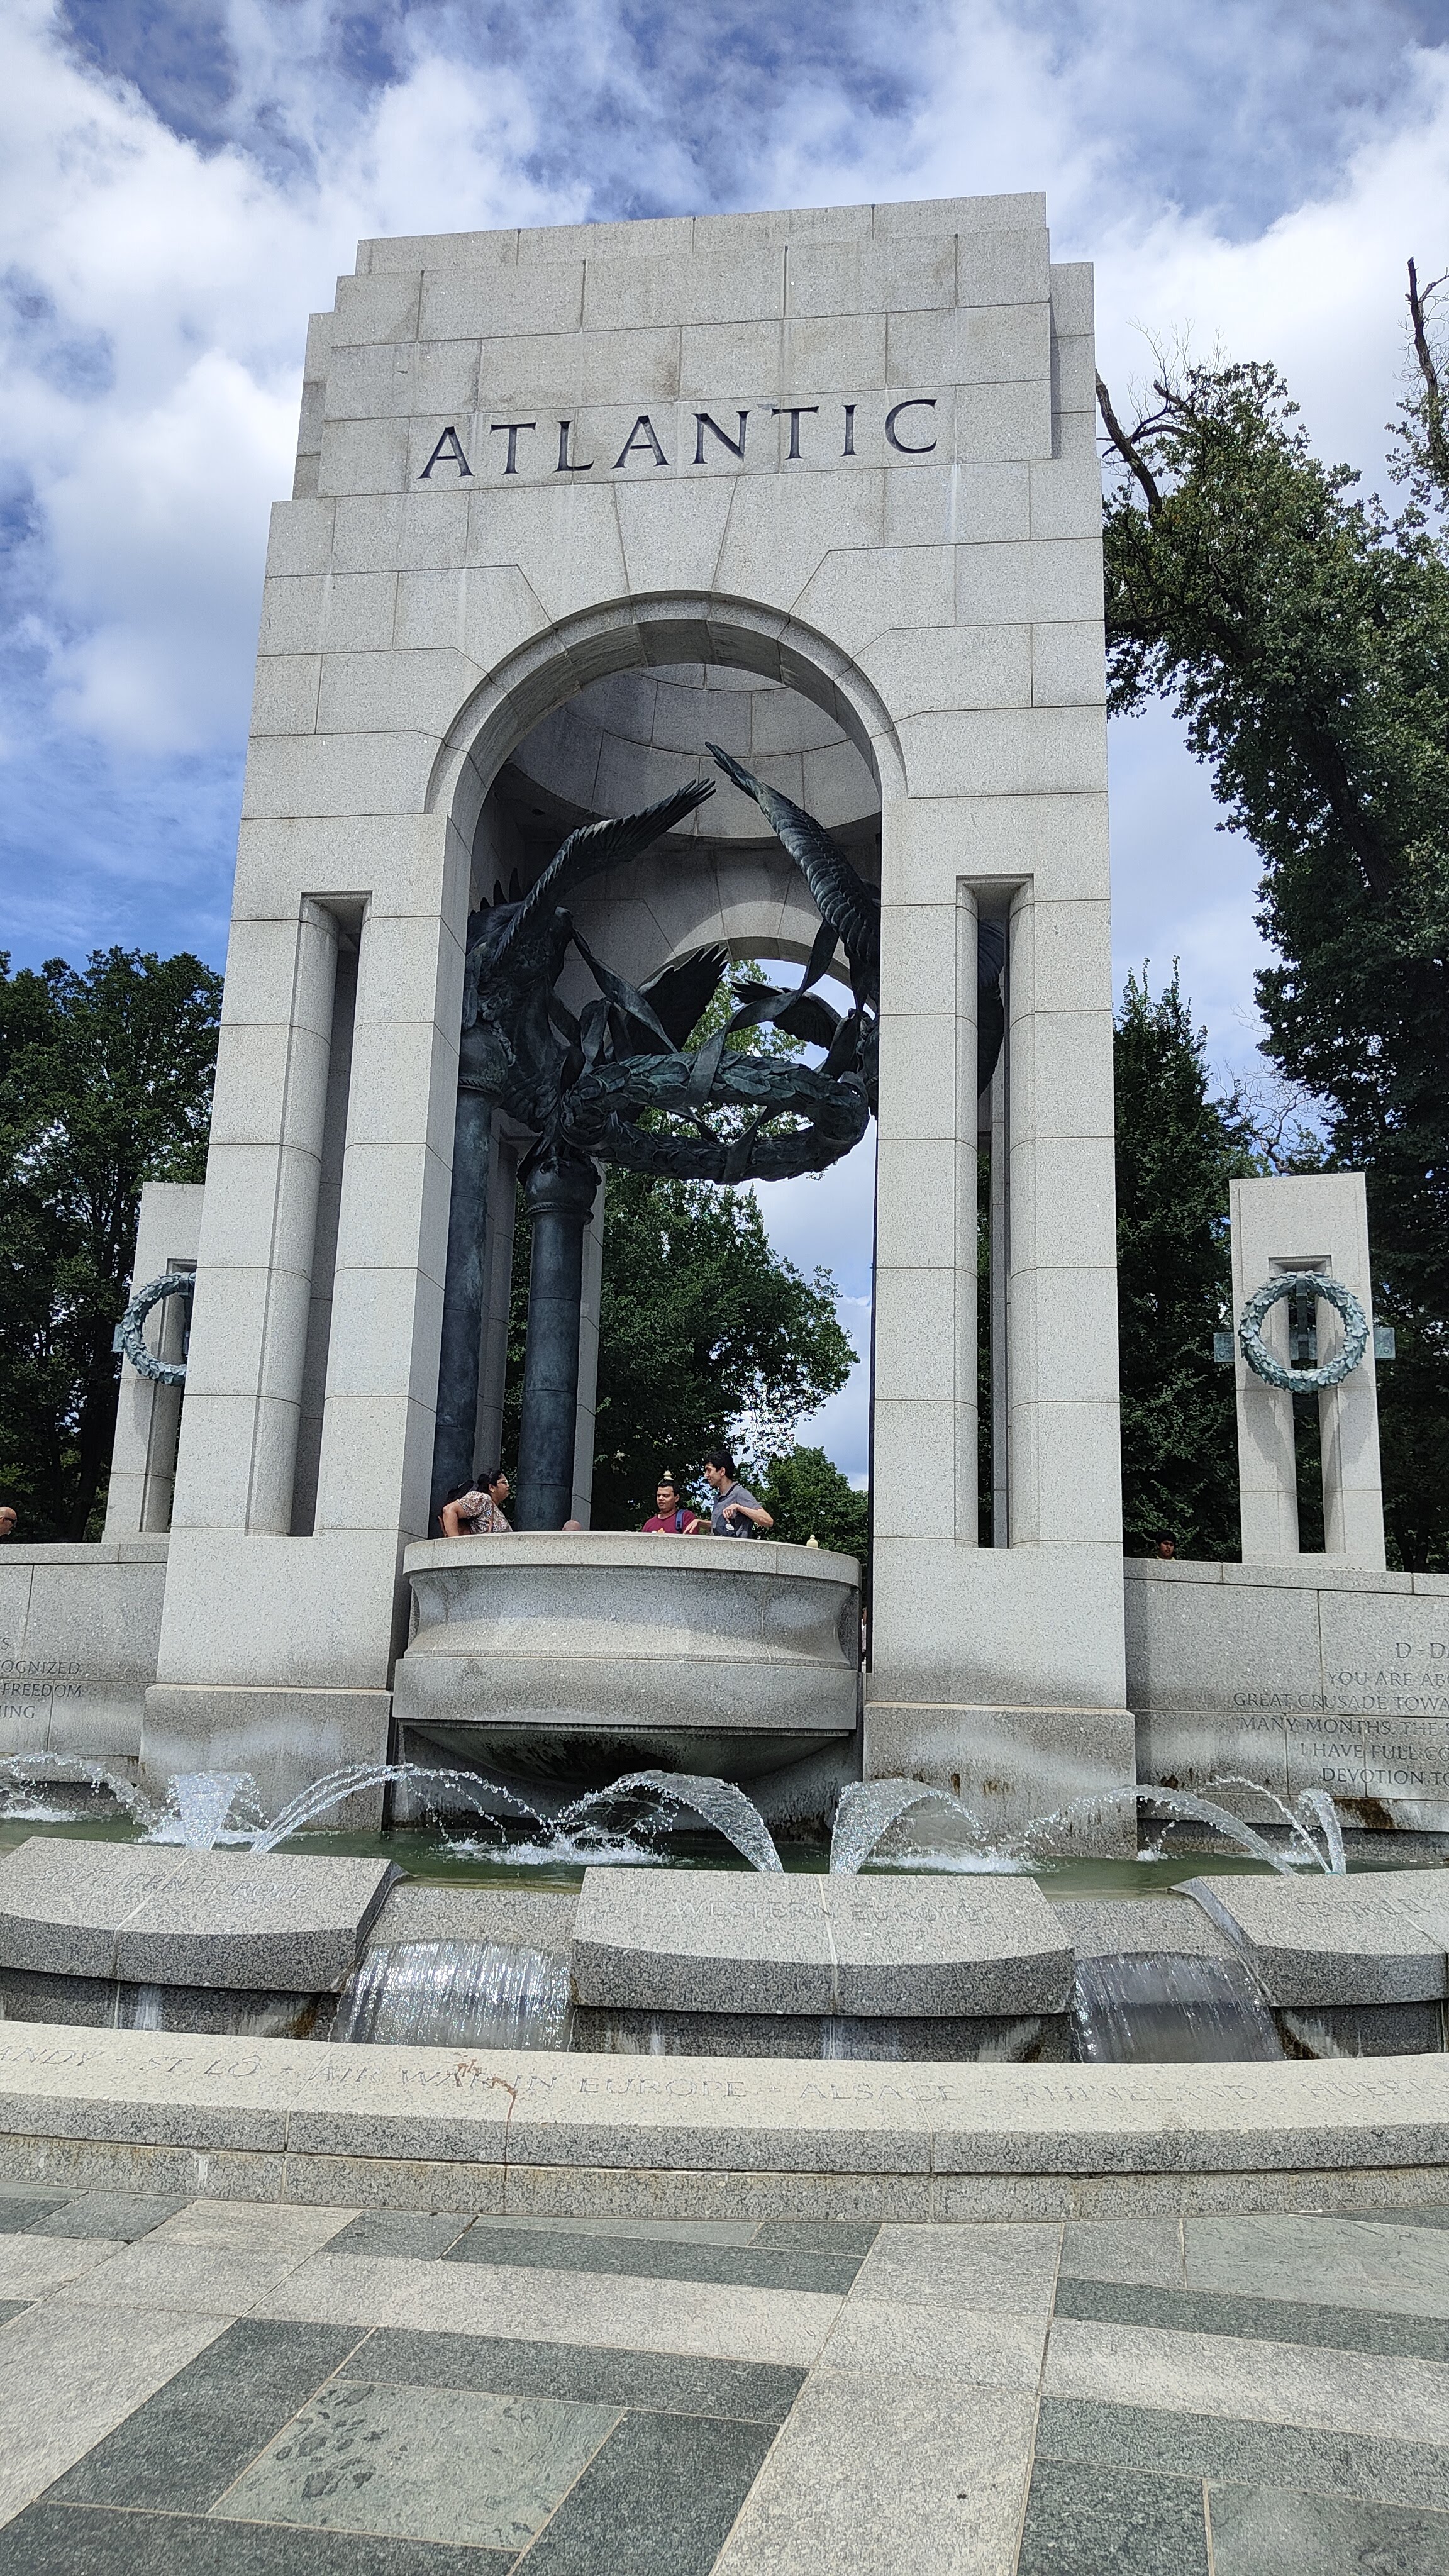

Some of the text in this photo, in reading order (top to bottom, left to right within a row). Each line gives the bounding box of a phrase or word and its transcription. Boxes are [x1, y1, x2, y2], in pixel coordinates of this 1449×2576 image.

[416, 398, 938, 480] ATLANTIC
[1396, 1642, 1449, 1660] D-D
[1, 1659, 80, 1675] OGNIZED
[1326, 1670, 1449, 1687] YOU ARE AB
[1, 1682, 82, 1698] FREEDOM
[1233, 1692, 1292, 1707] GREAT
[1297, 1694, 1388, 1711] CRUSADE
[1239, 1717, 1297, 1732] MANY
[1399, 1721, 1438, 1736] THE
[1301, 1743, 1306, 1757] I
[1313, 1743, 1363, 1758] HAVE
[1371, 1745, 1418, 1760] FULL
[1322, 1767, 1424, 1785] DEVOTION
[672, 1898, 838, 1919] WESTERN
[308, 2065, 379, 2084] AIR
[513, 2075, 558, 2091] IN
[579, 2077, 747, 2097] EUROPE
[799, 2083, 960, 2101] ALSACE
